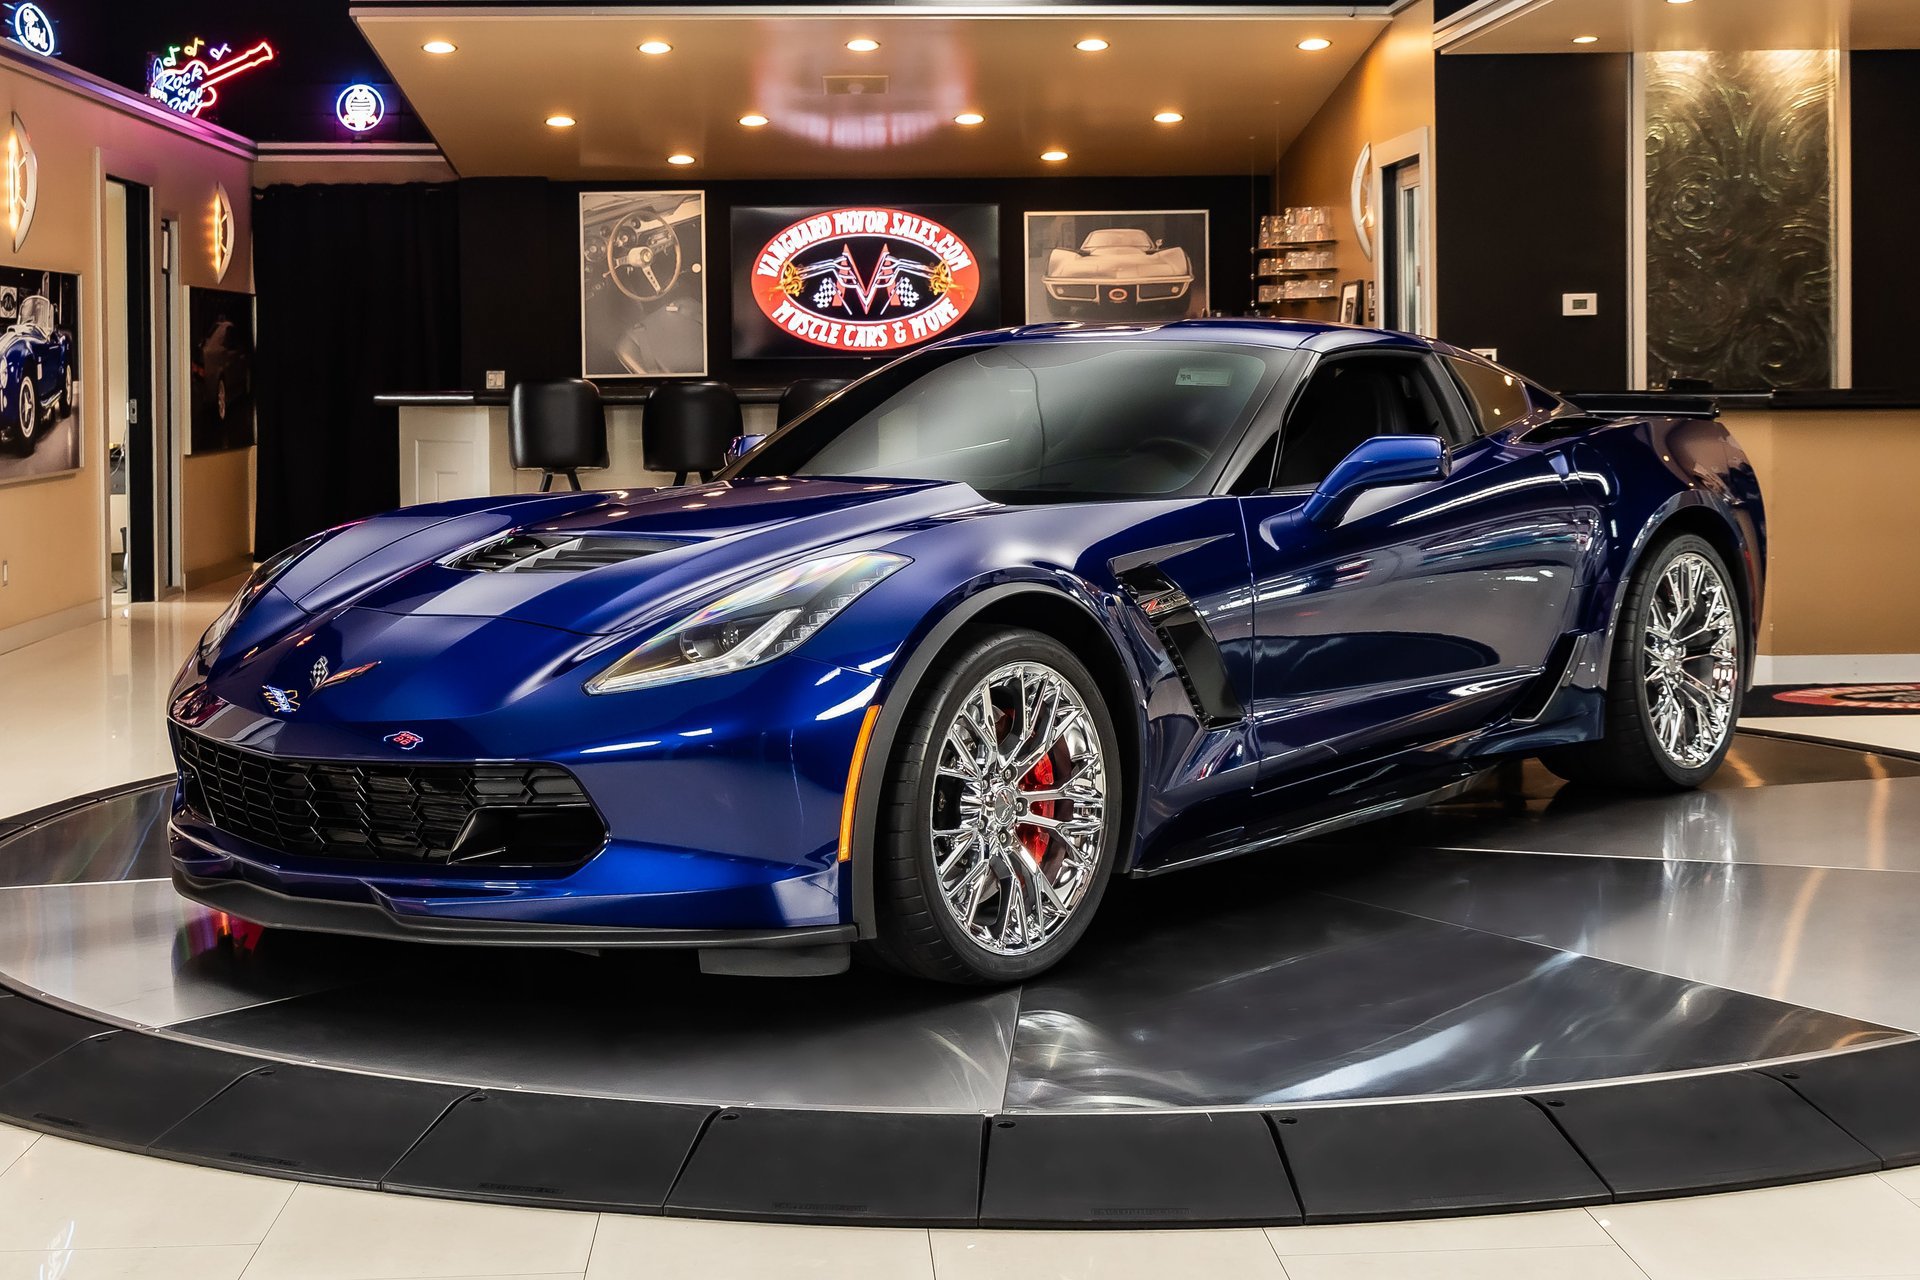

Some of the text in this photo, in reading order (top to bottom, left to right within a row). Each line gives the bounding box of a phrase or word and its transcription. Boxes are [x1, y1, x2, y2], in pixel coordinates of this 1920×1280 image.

[160, 63, 203, 92] Rock
[757, 210, 972, 278] VANGUARD MOTOR SALES.COM
[771, 297, 960, 348] MUSCLE CARS & MORE
